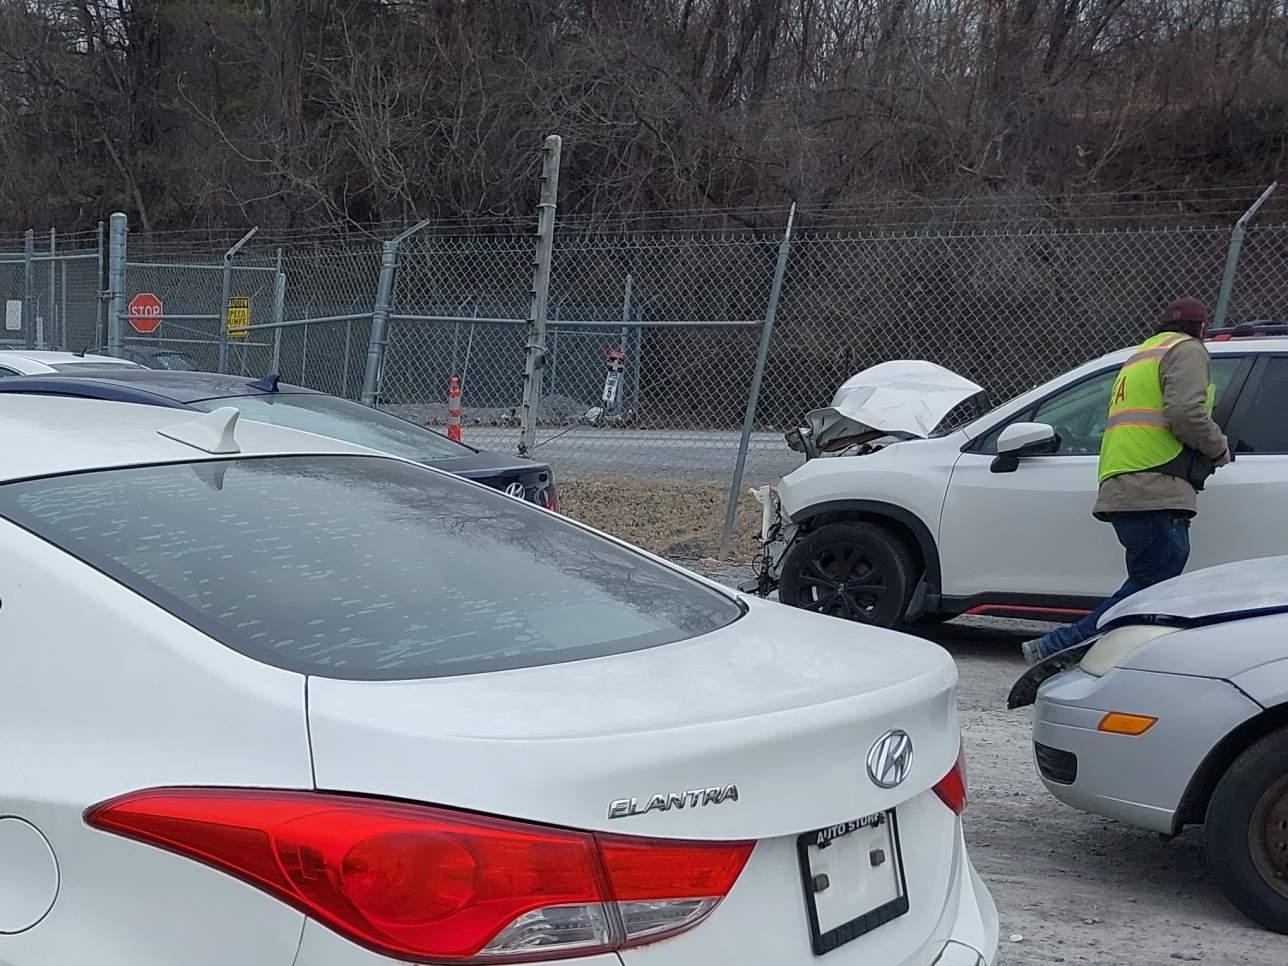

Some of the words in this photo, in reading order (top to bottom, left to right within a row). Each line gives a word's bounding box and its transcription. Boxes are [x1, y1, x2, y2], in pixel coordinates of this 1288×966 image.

[131, 305, 161, 316] STOP
[607, 783, 740, 819] ELANTRA
[817, 824, 846, 844] AUTO
